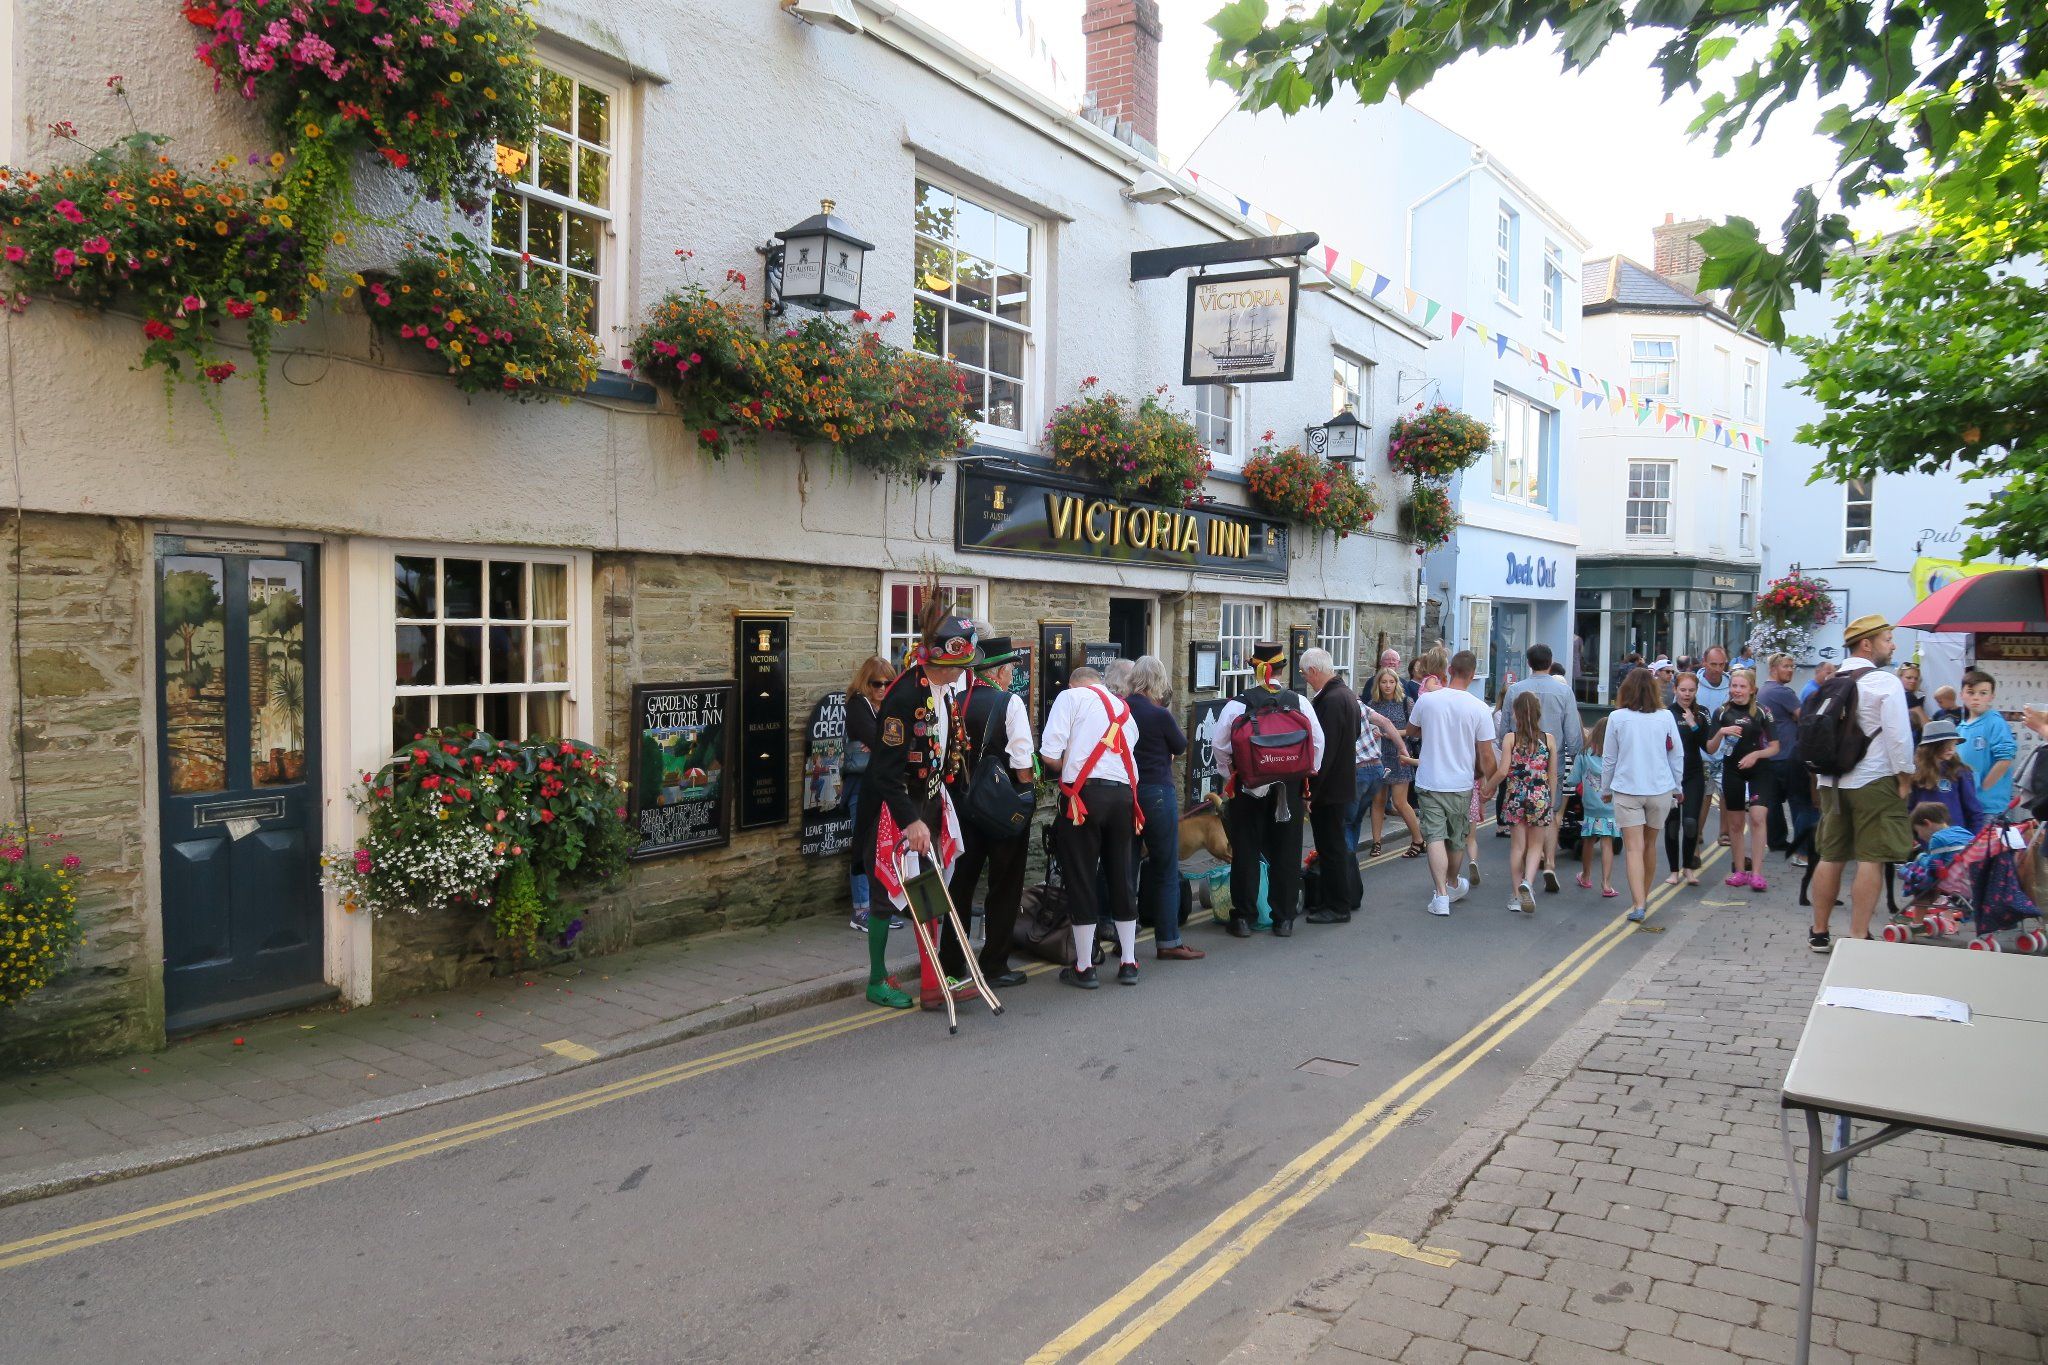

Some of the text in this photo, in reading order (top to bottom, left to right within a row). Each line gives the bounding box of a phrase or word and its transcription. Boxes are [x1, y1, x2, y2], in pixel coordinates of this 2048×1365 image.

[1200, 284, 1217, 294] THE
[1199, 287, 1285, 312] VICTORIA
[1047, 493, 1250, 559] VICTORIA INN
[1919, 526, 1962, 546] Pub
[1506, 551, 1557, 588] Deck Out
[750, 655, 779, 663] VICTORIA
[758, 665, 771, 673] INN
[647, 692, 721, 714] GARDENS AT
[828, 694, 847, 705] THE
[645, 708, 724, 729] VICTORIA INN
[820, 705, 847, 721] MAN
[928, 773, 940, 788] OLD
[805, 824, 823, 837] LEAVE
[824, 822, 839, 833] THEM
[802, 843, 820, 855] ENJOY
